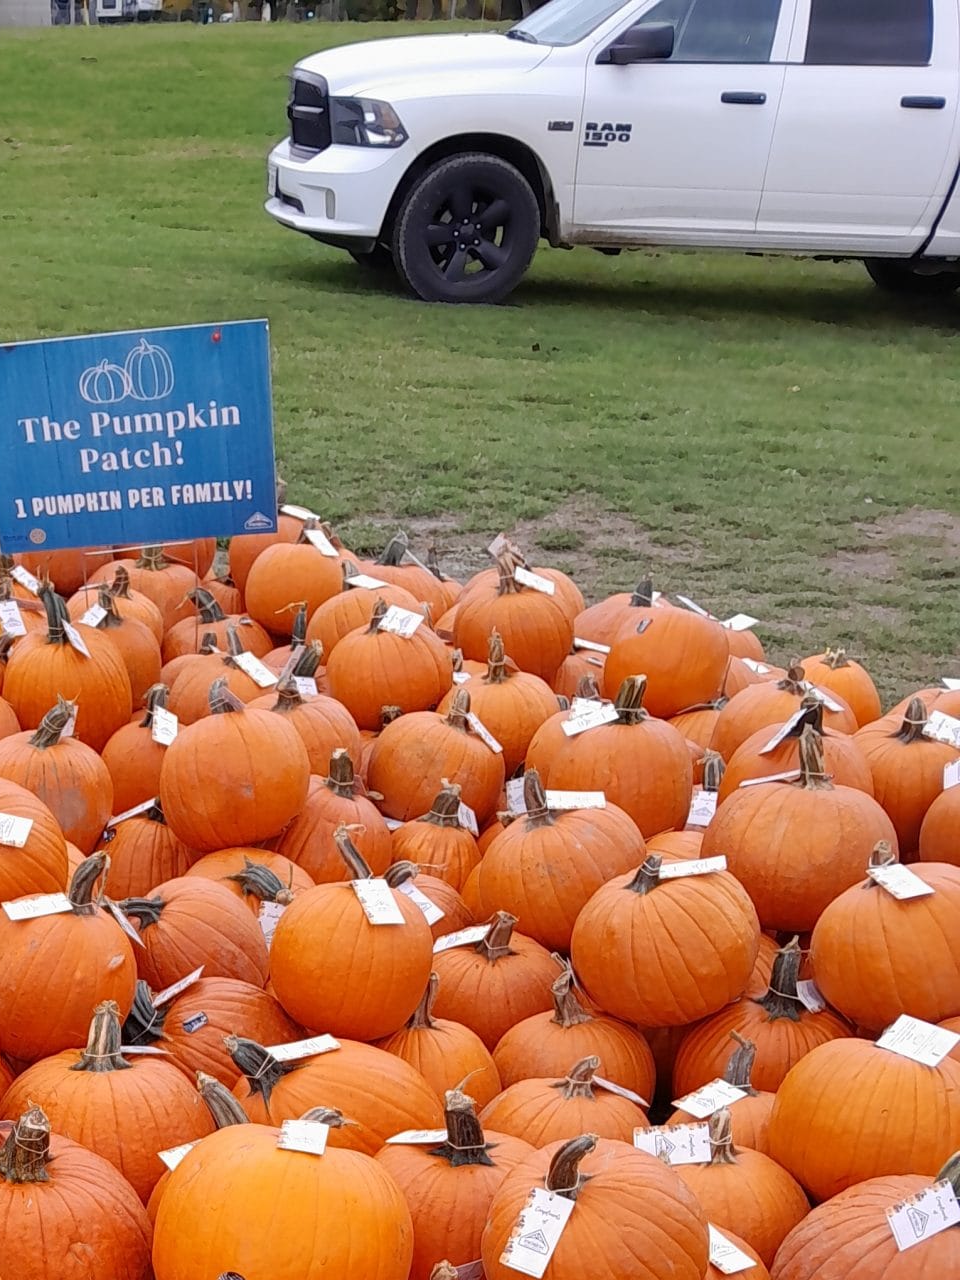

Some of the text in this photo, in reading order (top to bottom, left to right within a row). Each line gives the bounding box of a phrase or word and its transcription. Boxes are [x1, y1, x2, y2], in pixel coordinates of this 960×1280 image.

[584, 132, 631, 142] 1500
[585, 122, 632, 132] RAM
[17, 400, 241, 443] The Pumpkin
[79, 440, 184, 473] Patch!
[15, 479, 253, 518] 1 PUMPKIN PER FAMILY!
